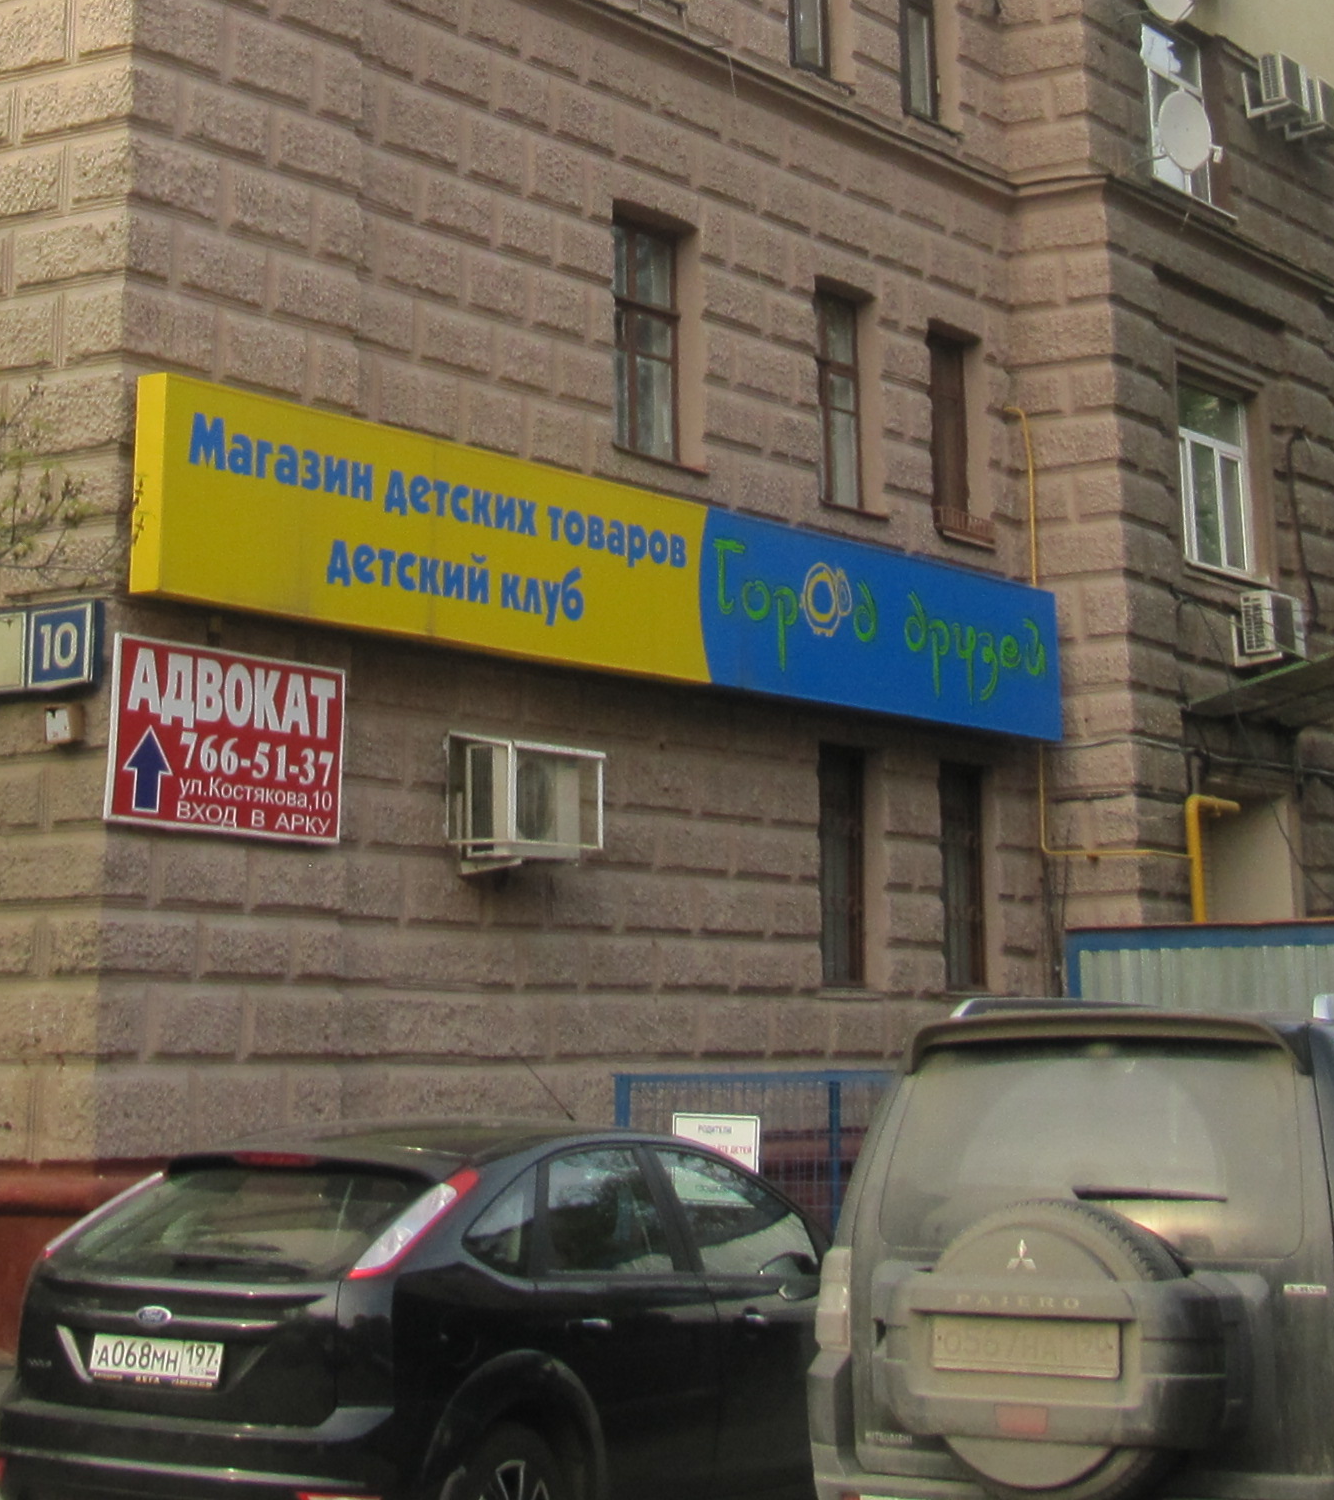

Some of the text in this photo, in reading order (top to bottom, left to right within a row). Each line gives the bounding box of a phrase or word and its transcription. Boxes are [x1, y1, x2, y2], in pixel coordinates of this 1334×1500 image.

[188, 412, 687, 569] Магазин детских товаров
[326, 539, 584, 627] детский клуб
[40, 621, 78, 671] 10
[904, 591, 1048, 706] друзей
[127, 647, 336, 739] АДВОКАТ
[179, 731, 334, 787] 766-51-37
[177, 801, 331, 835] ВХОД В АРКУ
[179, 777, 332, 812] ул.Костякова,10
[956, 1294, 1080, 1309] PAJERO
[185, 1344, 216, 1366] 197
